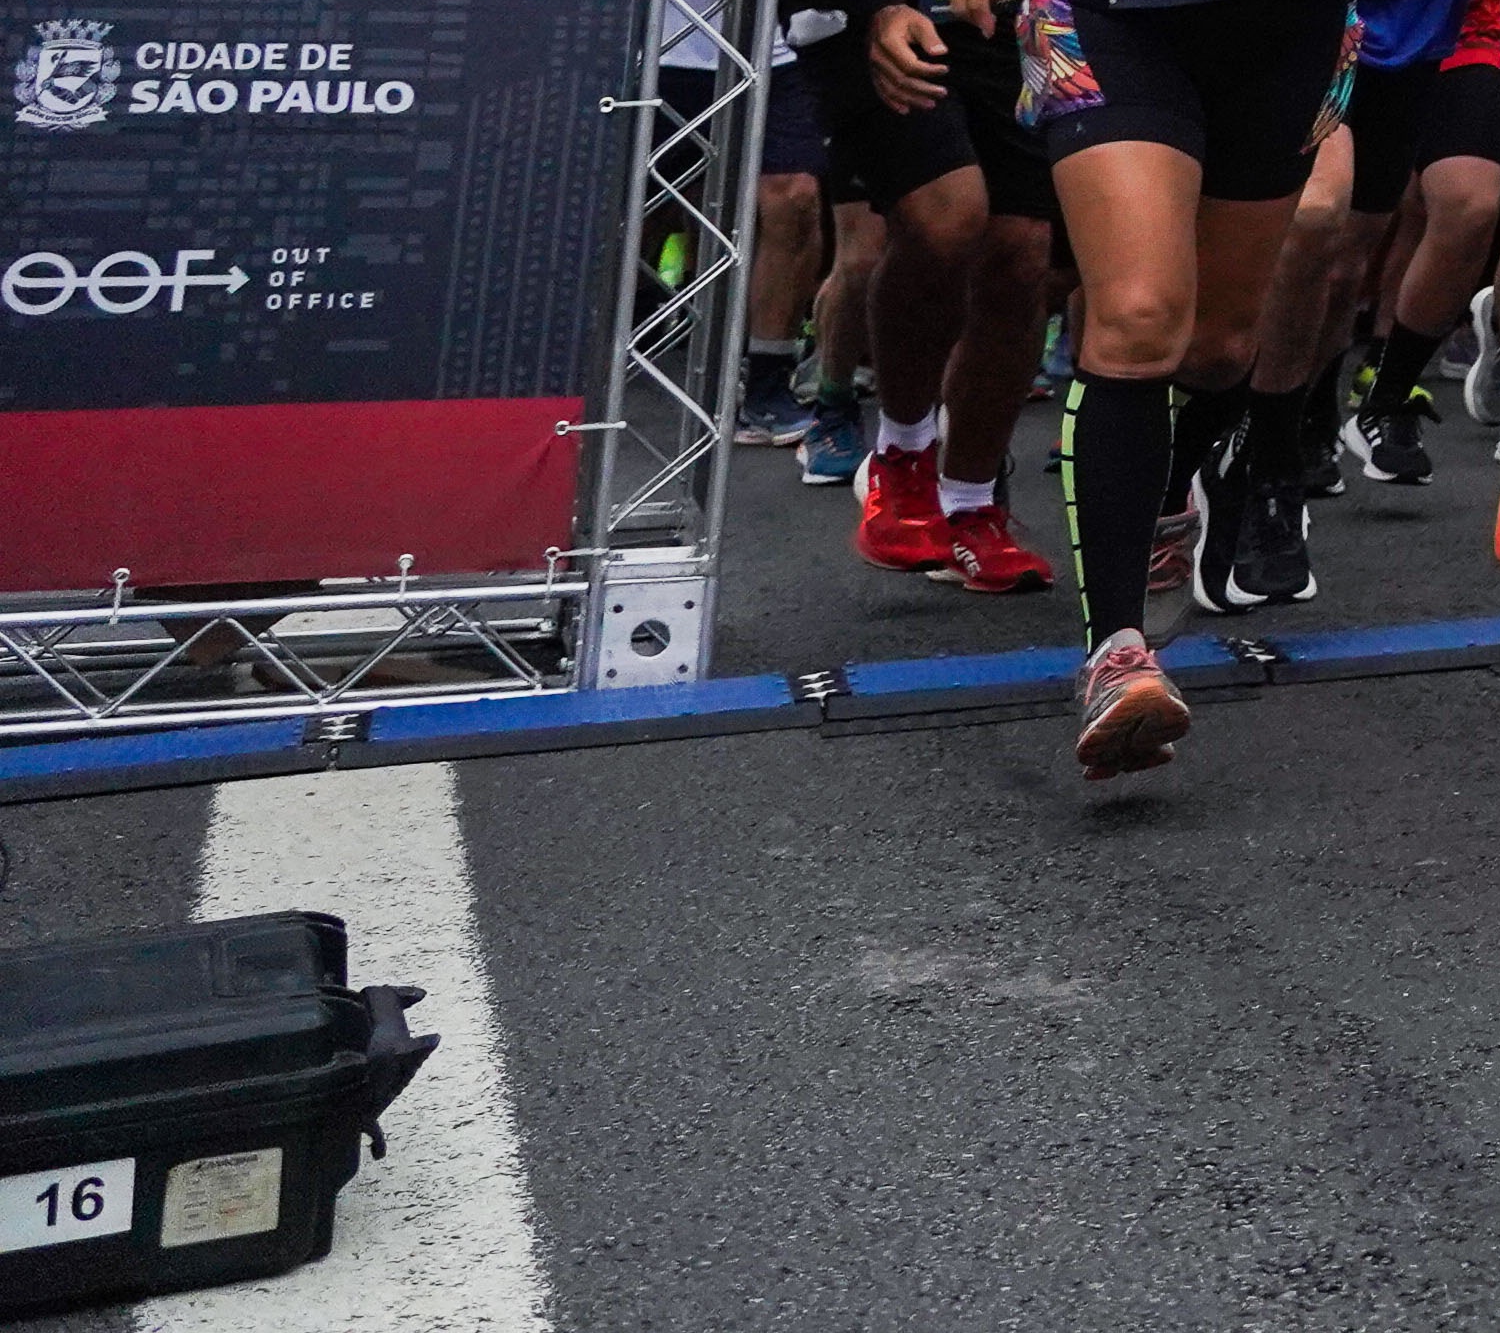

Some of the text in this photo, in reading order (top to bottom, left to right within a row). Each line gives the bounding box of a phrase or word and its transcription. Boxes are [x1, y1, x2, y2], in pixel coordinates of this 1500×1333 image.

[136, 42, 354, 71] CIDADE DE
[129, 74, 414, 114] SÃO PAULO
[2, 248, 330, 315] OOF OUT
[269, 271, 305, 287] OF
[267, 292, 374, 309] OFFICE
[37, 1176, 104, 1227] 16
